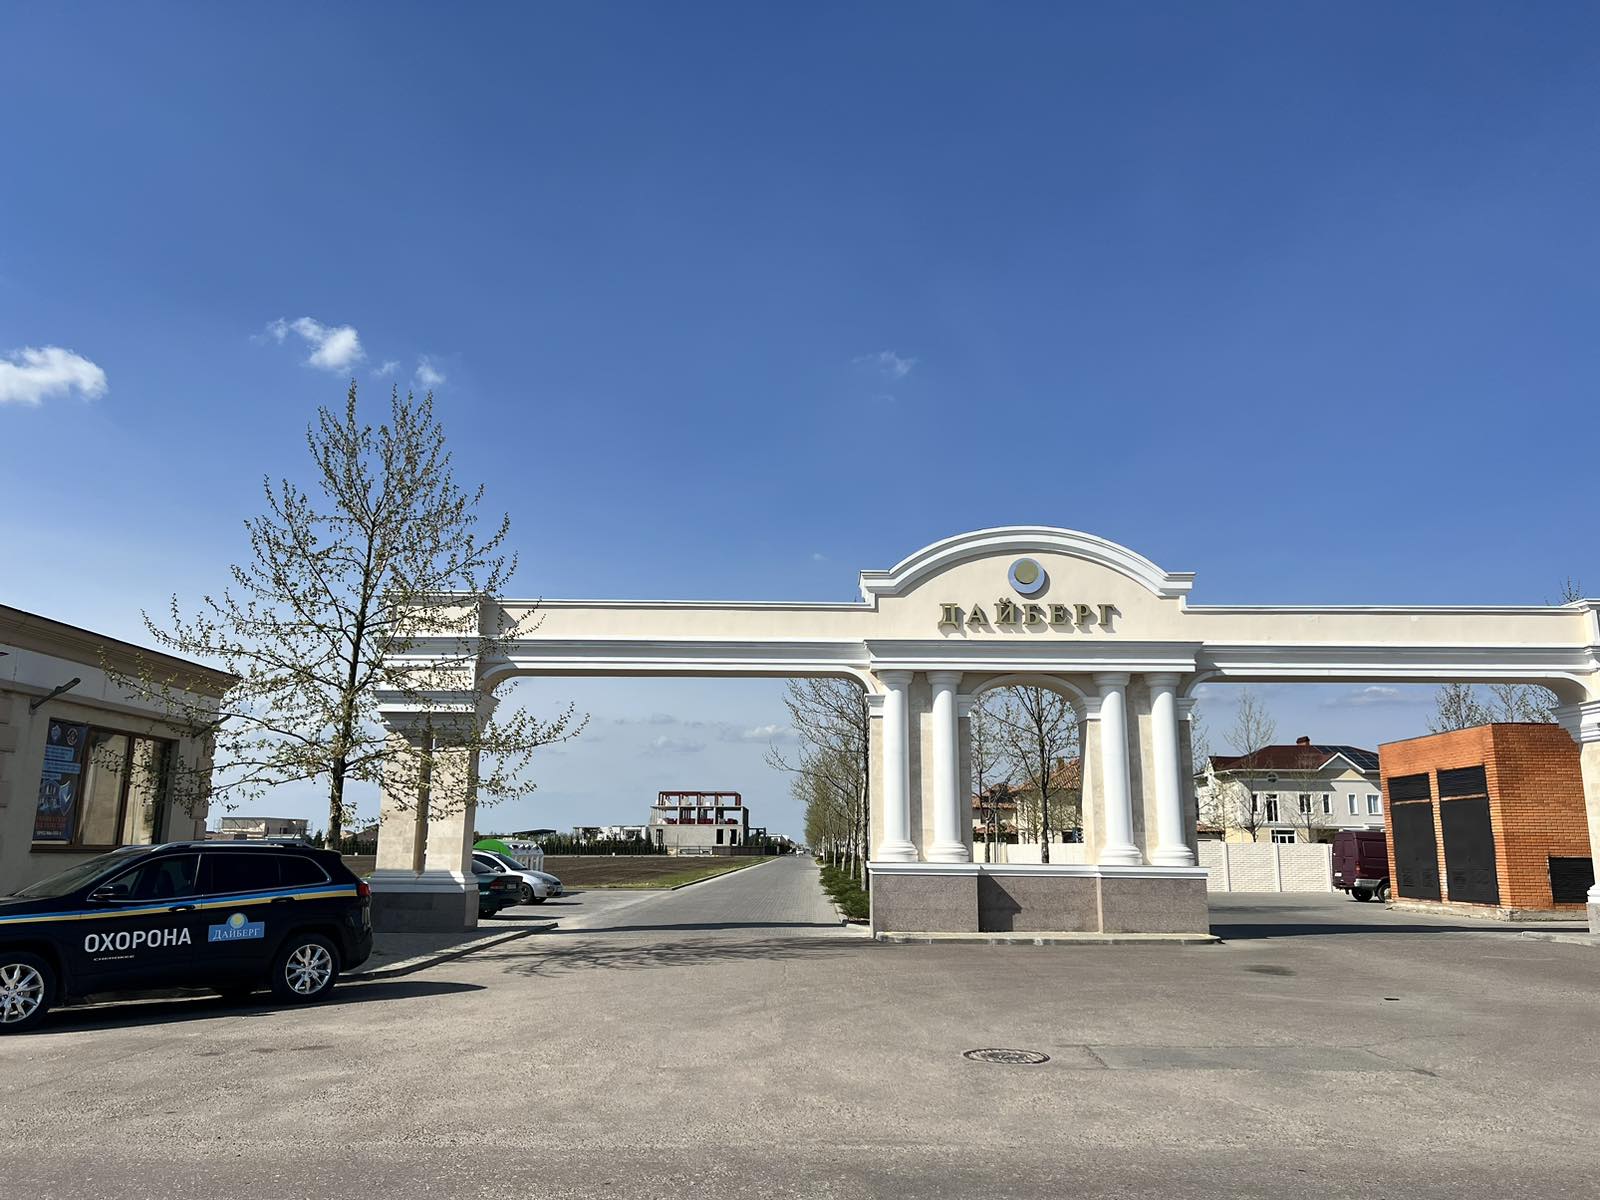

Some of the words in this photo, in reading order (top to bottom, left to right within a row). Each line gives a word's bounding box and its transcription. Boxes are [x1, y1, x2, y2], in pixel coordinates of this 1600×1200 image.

[939, 598, 1115, 629] ДАЙБЕРГ
[84, 927, 192, 953] ОХОРОНА
[211, 928, 260, 941] ДАЙБЕРГ
